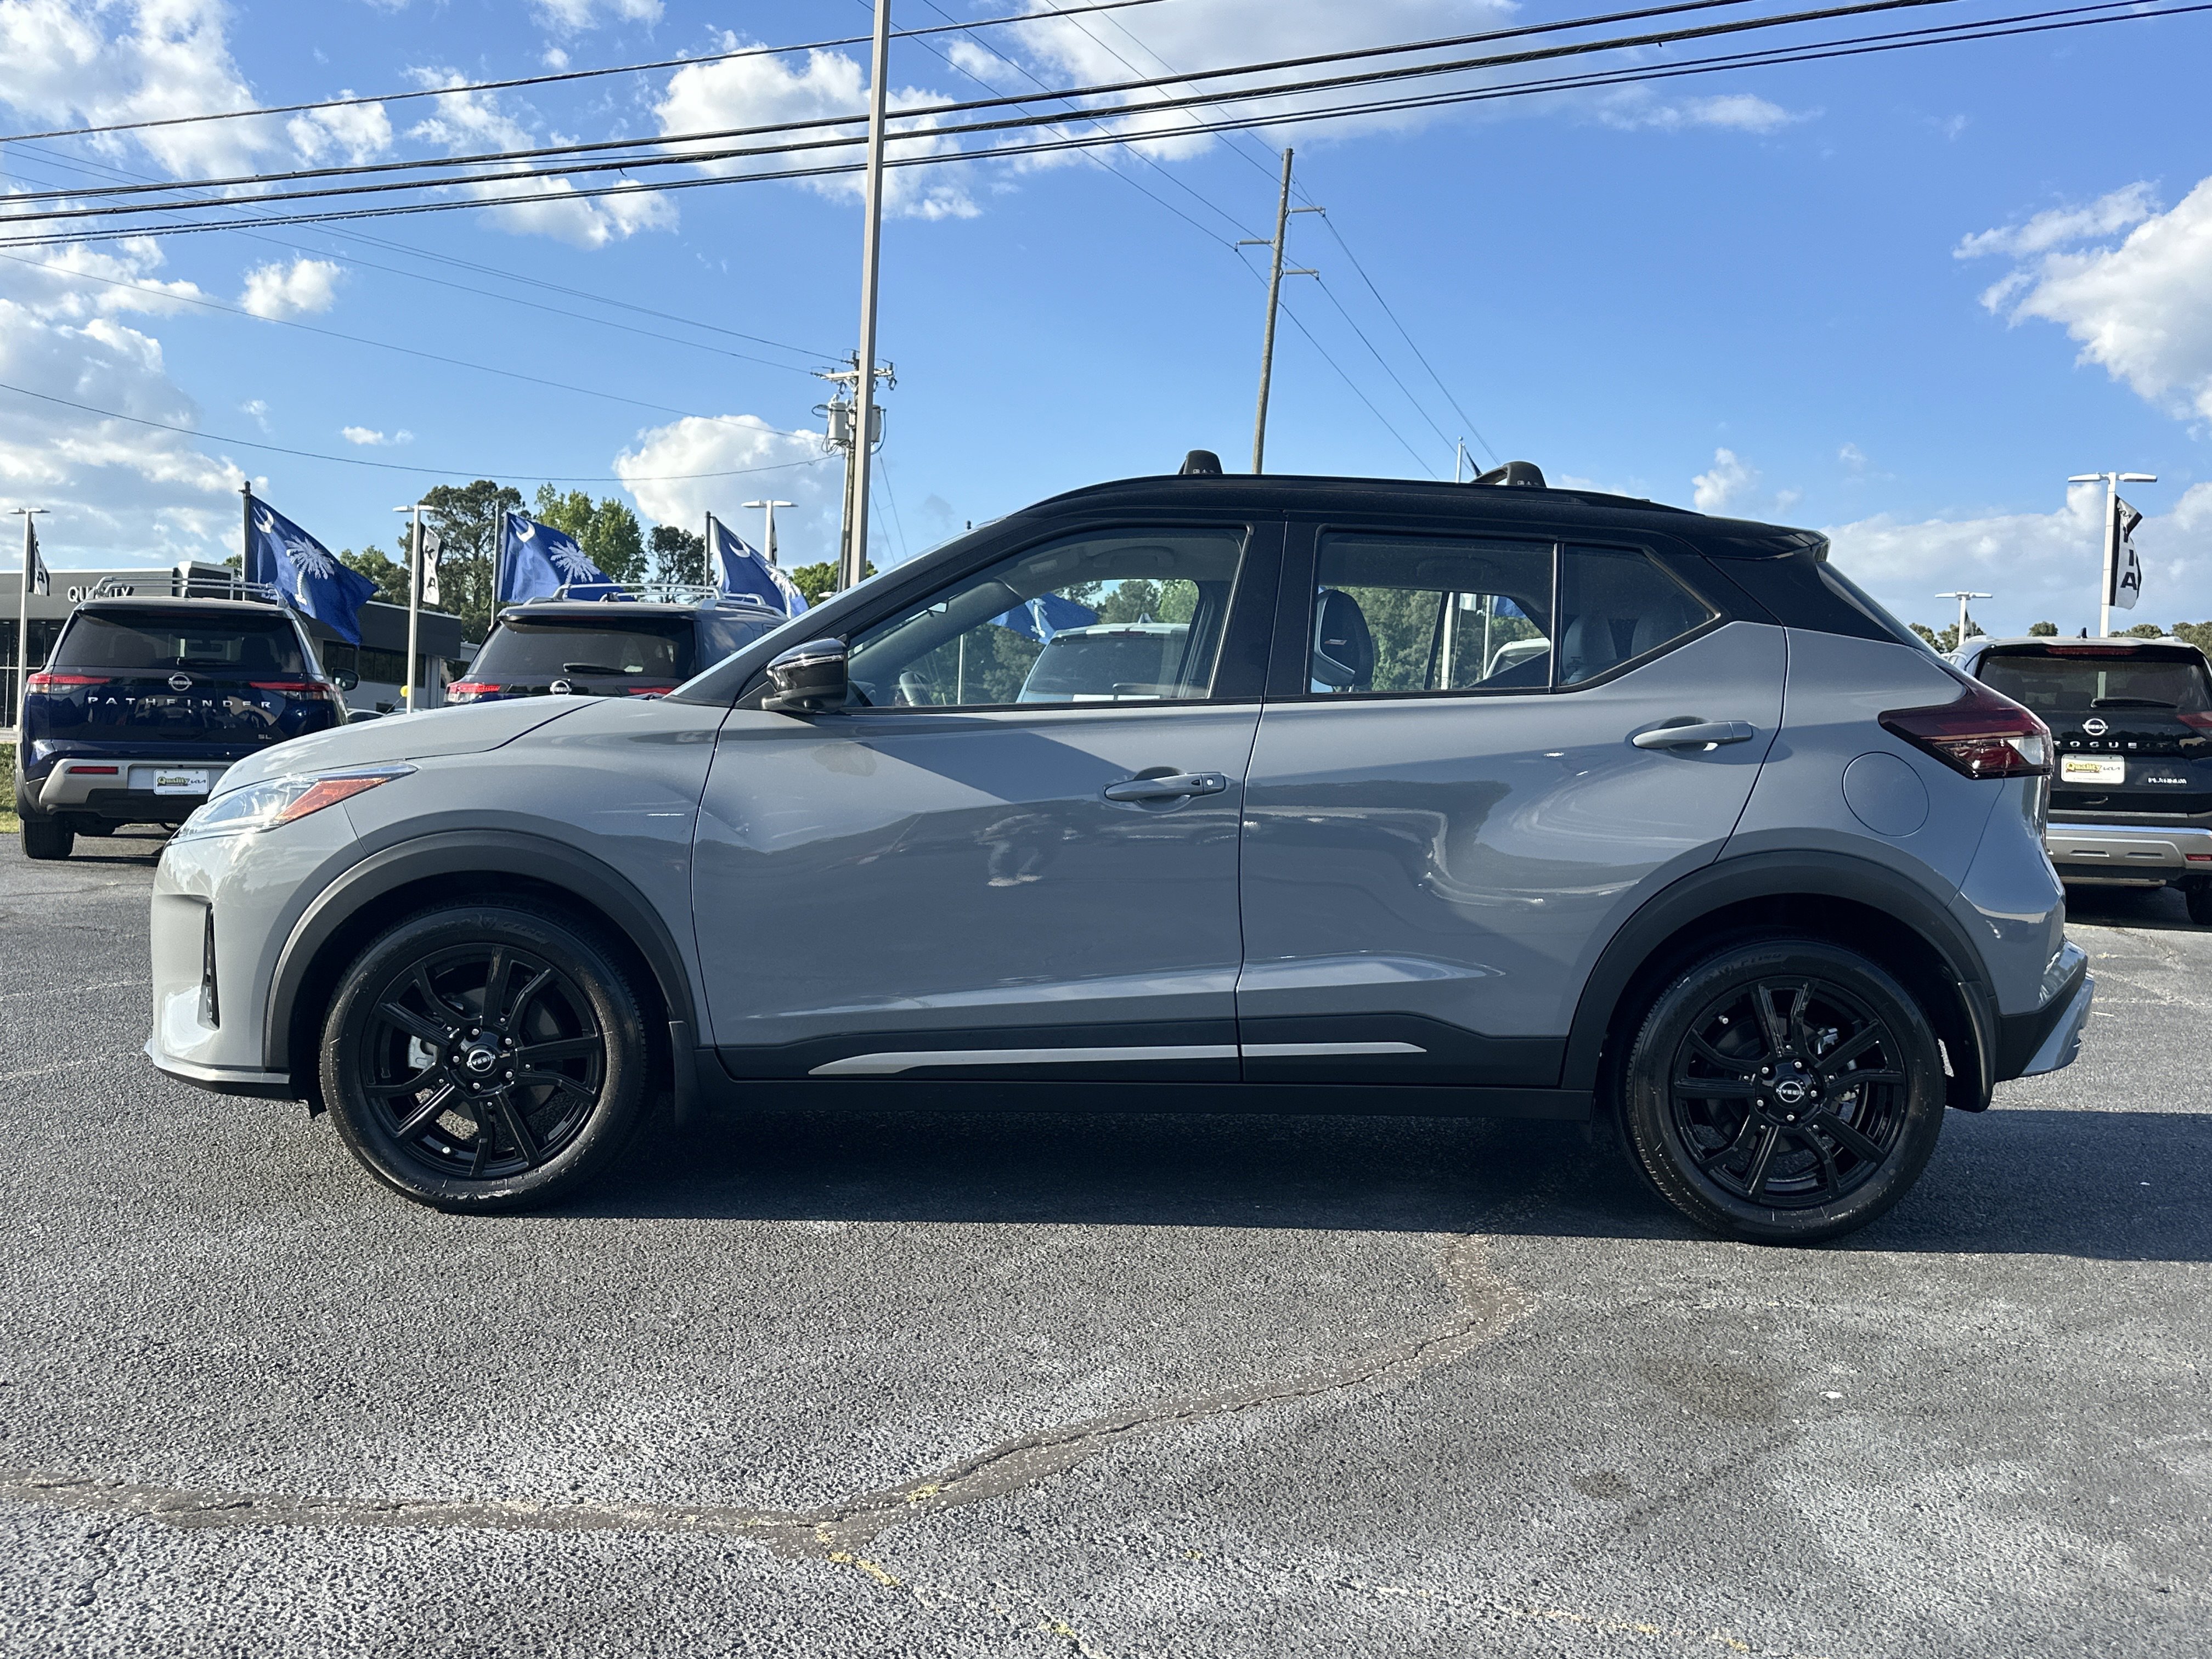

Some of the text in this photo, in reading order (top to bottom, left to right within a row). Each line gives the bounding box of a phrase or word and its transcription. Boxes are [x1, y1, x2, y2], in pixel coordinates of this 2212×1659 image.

[88, 696, 271, 708] PATHFINDER
[2052, 740, 2137, 749] ROGUE
[2066, 762, 2102, 772] Quality
[157, 776, 190, 785] Quality
